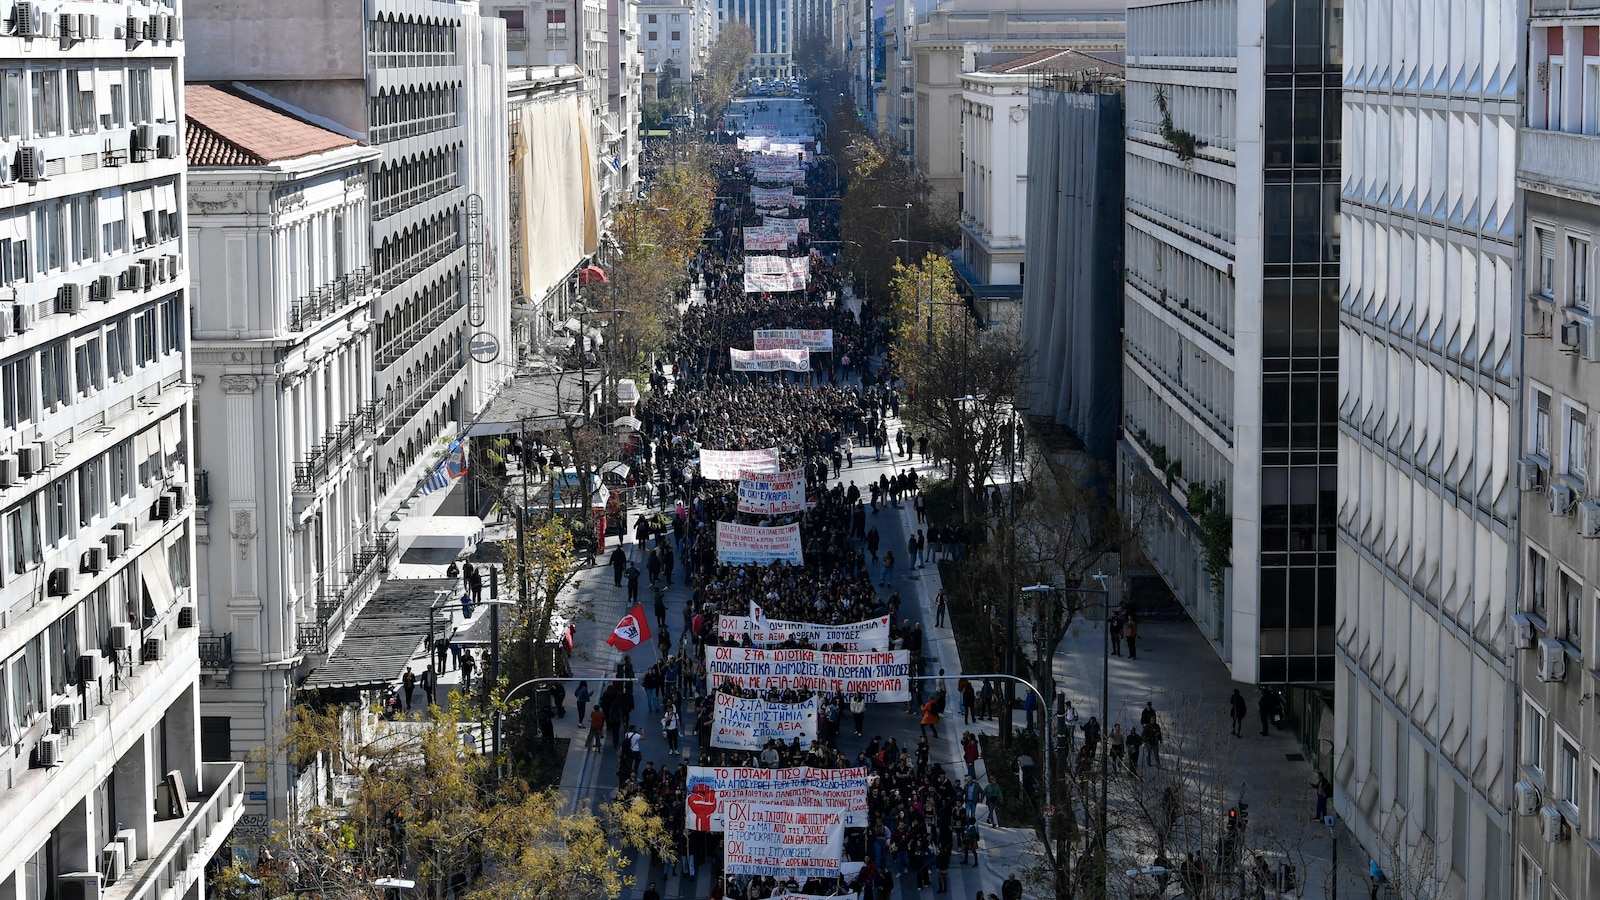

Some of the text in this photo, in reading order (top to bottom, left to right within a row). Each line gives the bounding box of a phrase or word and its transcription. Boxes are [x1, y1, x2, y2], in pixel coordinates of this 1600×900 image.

[721, 618, 738, 630] ΟΧΙ
[769, 621, 803, 630] ΔΙΩΤΙΚΑ
[754, 632, 764, 641] ΜΕ
[769, 632, 785, 641] ΑΞΙΑ
[827, 630, 860, 640] ΣΠΟΥΔΕΣ
[716, 647, 895, 666] ΟΧΙ ΣΤΑ ΙΔΙΩΤΙΚΑ ΠΑΝΕΠΙΣΤΗΜΙΑ
[710, 661, 909, 678] ΑΠΟΚΛΕΙΣΤΙΚΑ ΔΗΜΟΣΙΕΣ ΚΑΙ ΔΩΡΕΑΝ ΣΠΟΥΔΕΣ
[713, 674, 744, 688] ΠΤΧΙΑ
[749, 676, 761, 689] ΜΕ
[831, 679, 843, 691] ΜΕ
[846, 678, 902, 692] ΔΙΚΑΙΩΜΑΤΑ
[717, 693, 735, 708] ΟΧΙ
[740, 699, 763, 711] ΣΤΑ
[724, 707, 803, 722] ΠΑΝΕΠΙΣΤΗΜΙΑ
[720, 718, 751, 729] ΠΤΥΧΙΑ
[777, 722, 803, 731] ΑΞΙΑ
[718, 728, 786, 737] ΔΩΡΕΑΝ ΣΠΟΥΔΕΣ
[714, 768, 729, 780] ΤΟ
[733, 768, 771, 780] ΠΟΤΑΜΙ
[776, 768, 801, 780] ΠΙΣΩ
[805, 767, 828, 781] ΔΕΝ
[714, 779, 727, 789] ΝΑ
[728, 780, 770, 790] ΑΠΟΣΥΡΘΕΙ
[720, 790, 731, 798] ΟΧΙ
[732, 790, 744, 798] ΣΤΑ
[745, 789, 774, 798] ΙΔΙΩΤΙΚΑ
[729, 802, 750, 821] ΟΧΙ
[752, 811, 764, 822] ΣΤΑ
[765, 811, 793, 824] ΙΔΙΩΤΙΚΑ
[796, 812, 840, 825] ΠΑΝΕΠΙΣΤΗΜΙΑ
[728, 820, 746, 831] ΕΞΩ
[757, 822, 773, 832] ΜΑΤ
[773, 823, 787, 834] ΑΠΟ
[789, 827, 800, 835] ΤΙΣ
[803, 825, 828, 835] ΣΧΟΛΕΣ
[736, 831, 781, 844] ΤΡΟΜΟΚΡΑΤΙΑ
[783, 834, 794, 845] ΔΕΝ
[795, 835, 804, 845] ΘΑ
[806, 836, 829, 845] ΠΕΡΑΣΕΙ
[727, 840, 745, 855] ΟΧΙ
[748, 847, 766, 856] ΣΤΙΣ
[728, 854, 753, 864] ΠΤΥΧΙΑ
[764, 856, 780, 866] ΑΞΙΑ
[785, 858, 809, 868] ΔΩΡΕΑΝ
[810, 858, 840, 868] ΣΠΟΥΔΕΣ
